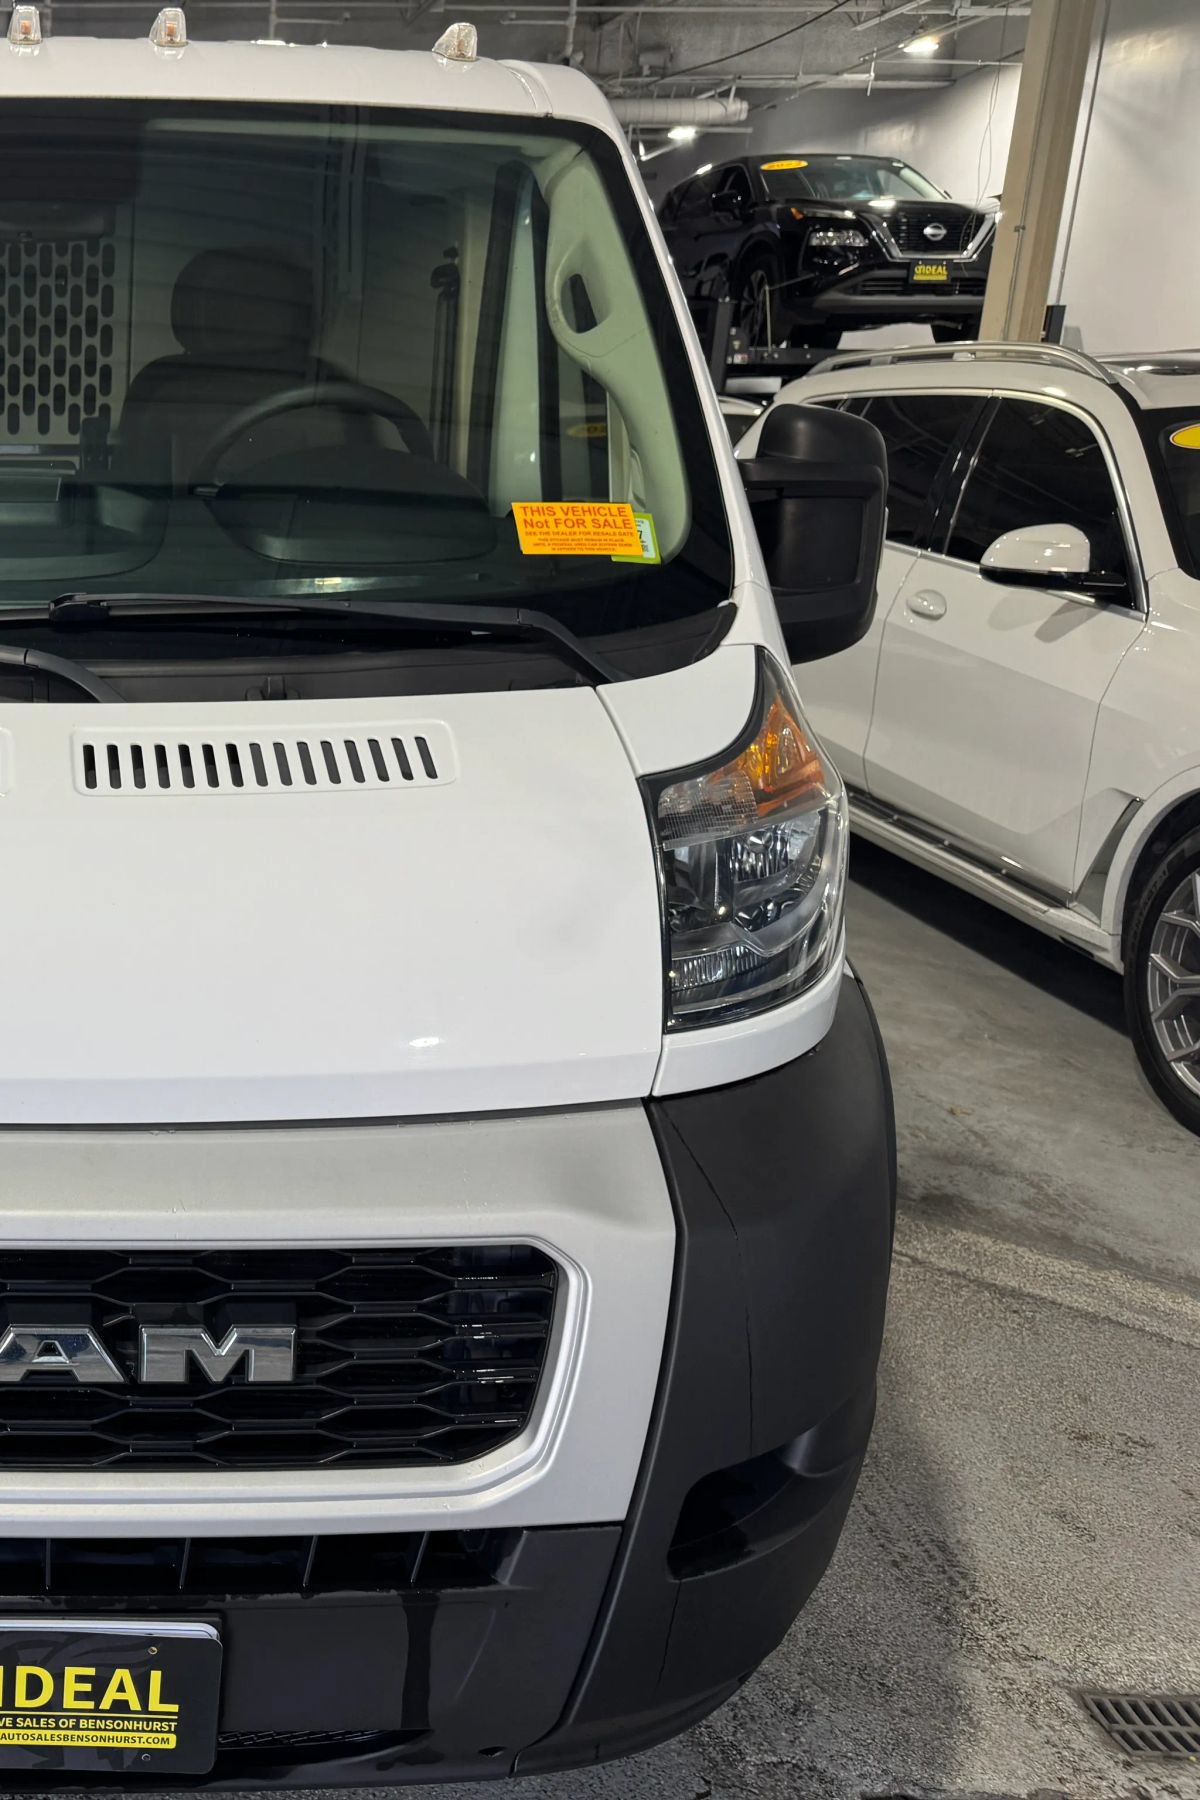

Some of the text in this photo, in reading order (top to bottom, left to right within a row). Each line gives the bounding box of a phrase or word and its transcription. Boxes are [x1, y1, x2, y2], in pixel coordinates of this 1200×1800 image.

[520, 505, 629, 517] THIS VEHICLE
[523, 518, 551, 529] Not
[553, 518, 587, 529] FOR
[591, 518, 634, 530] SALE
[16, 1717, 56, 1729] SALES
[58, 1718, 76, 1729] OF
[79, 1719, 177, 1732] BENSONHURST
